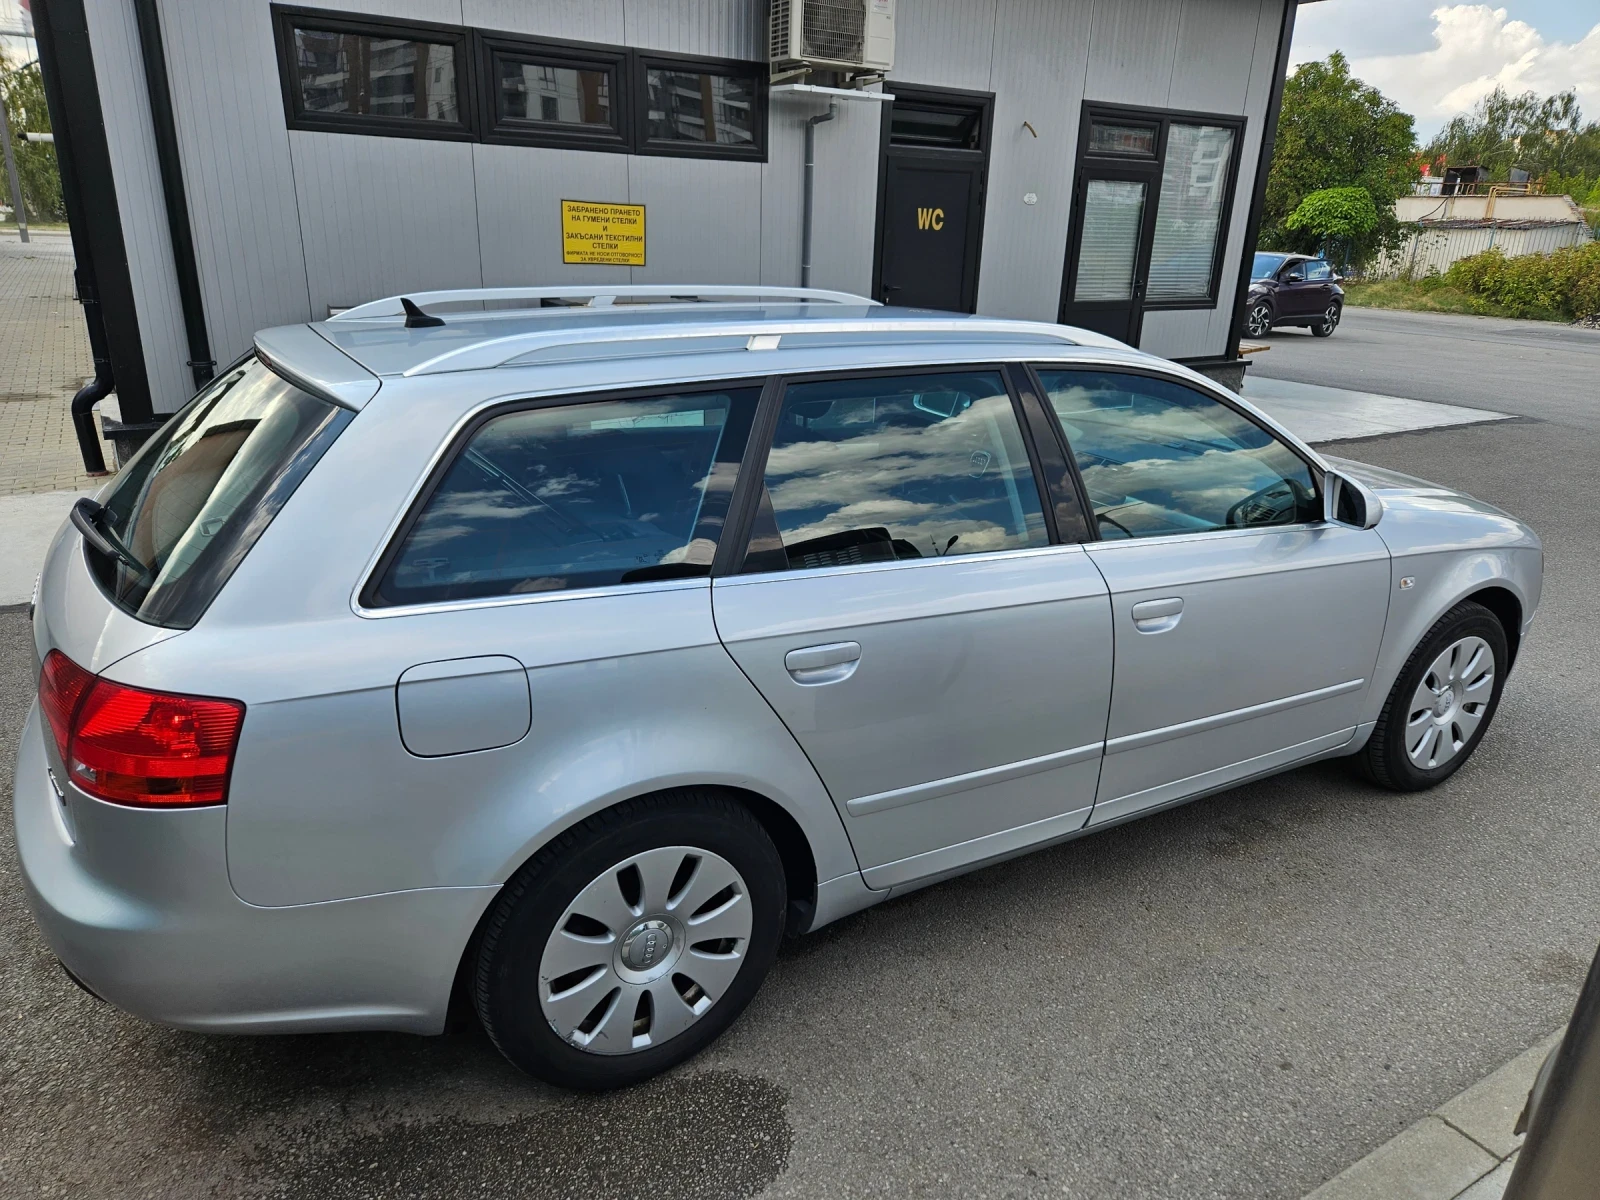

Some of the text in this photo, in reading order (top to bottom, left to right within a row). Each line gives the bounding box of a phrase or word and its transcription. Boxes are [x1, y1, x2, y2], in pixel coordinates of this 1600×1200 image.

[567, 205, 641, 217] ЗАБРАНЕНО ПРАНЕТО
[571, 214, 637, 225] НА ГУМЕНИ СТЕЛКИ
[918, 207, 944, 230] WC
[565, 232, 643, 243] ЗАКЪСАНИ ТЕКСТИЛНИ
[592, 242, 619, 250] СТЕЛКИ
